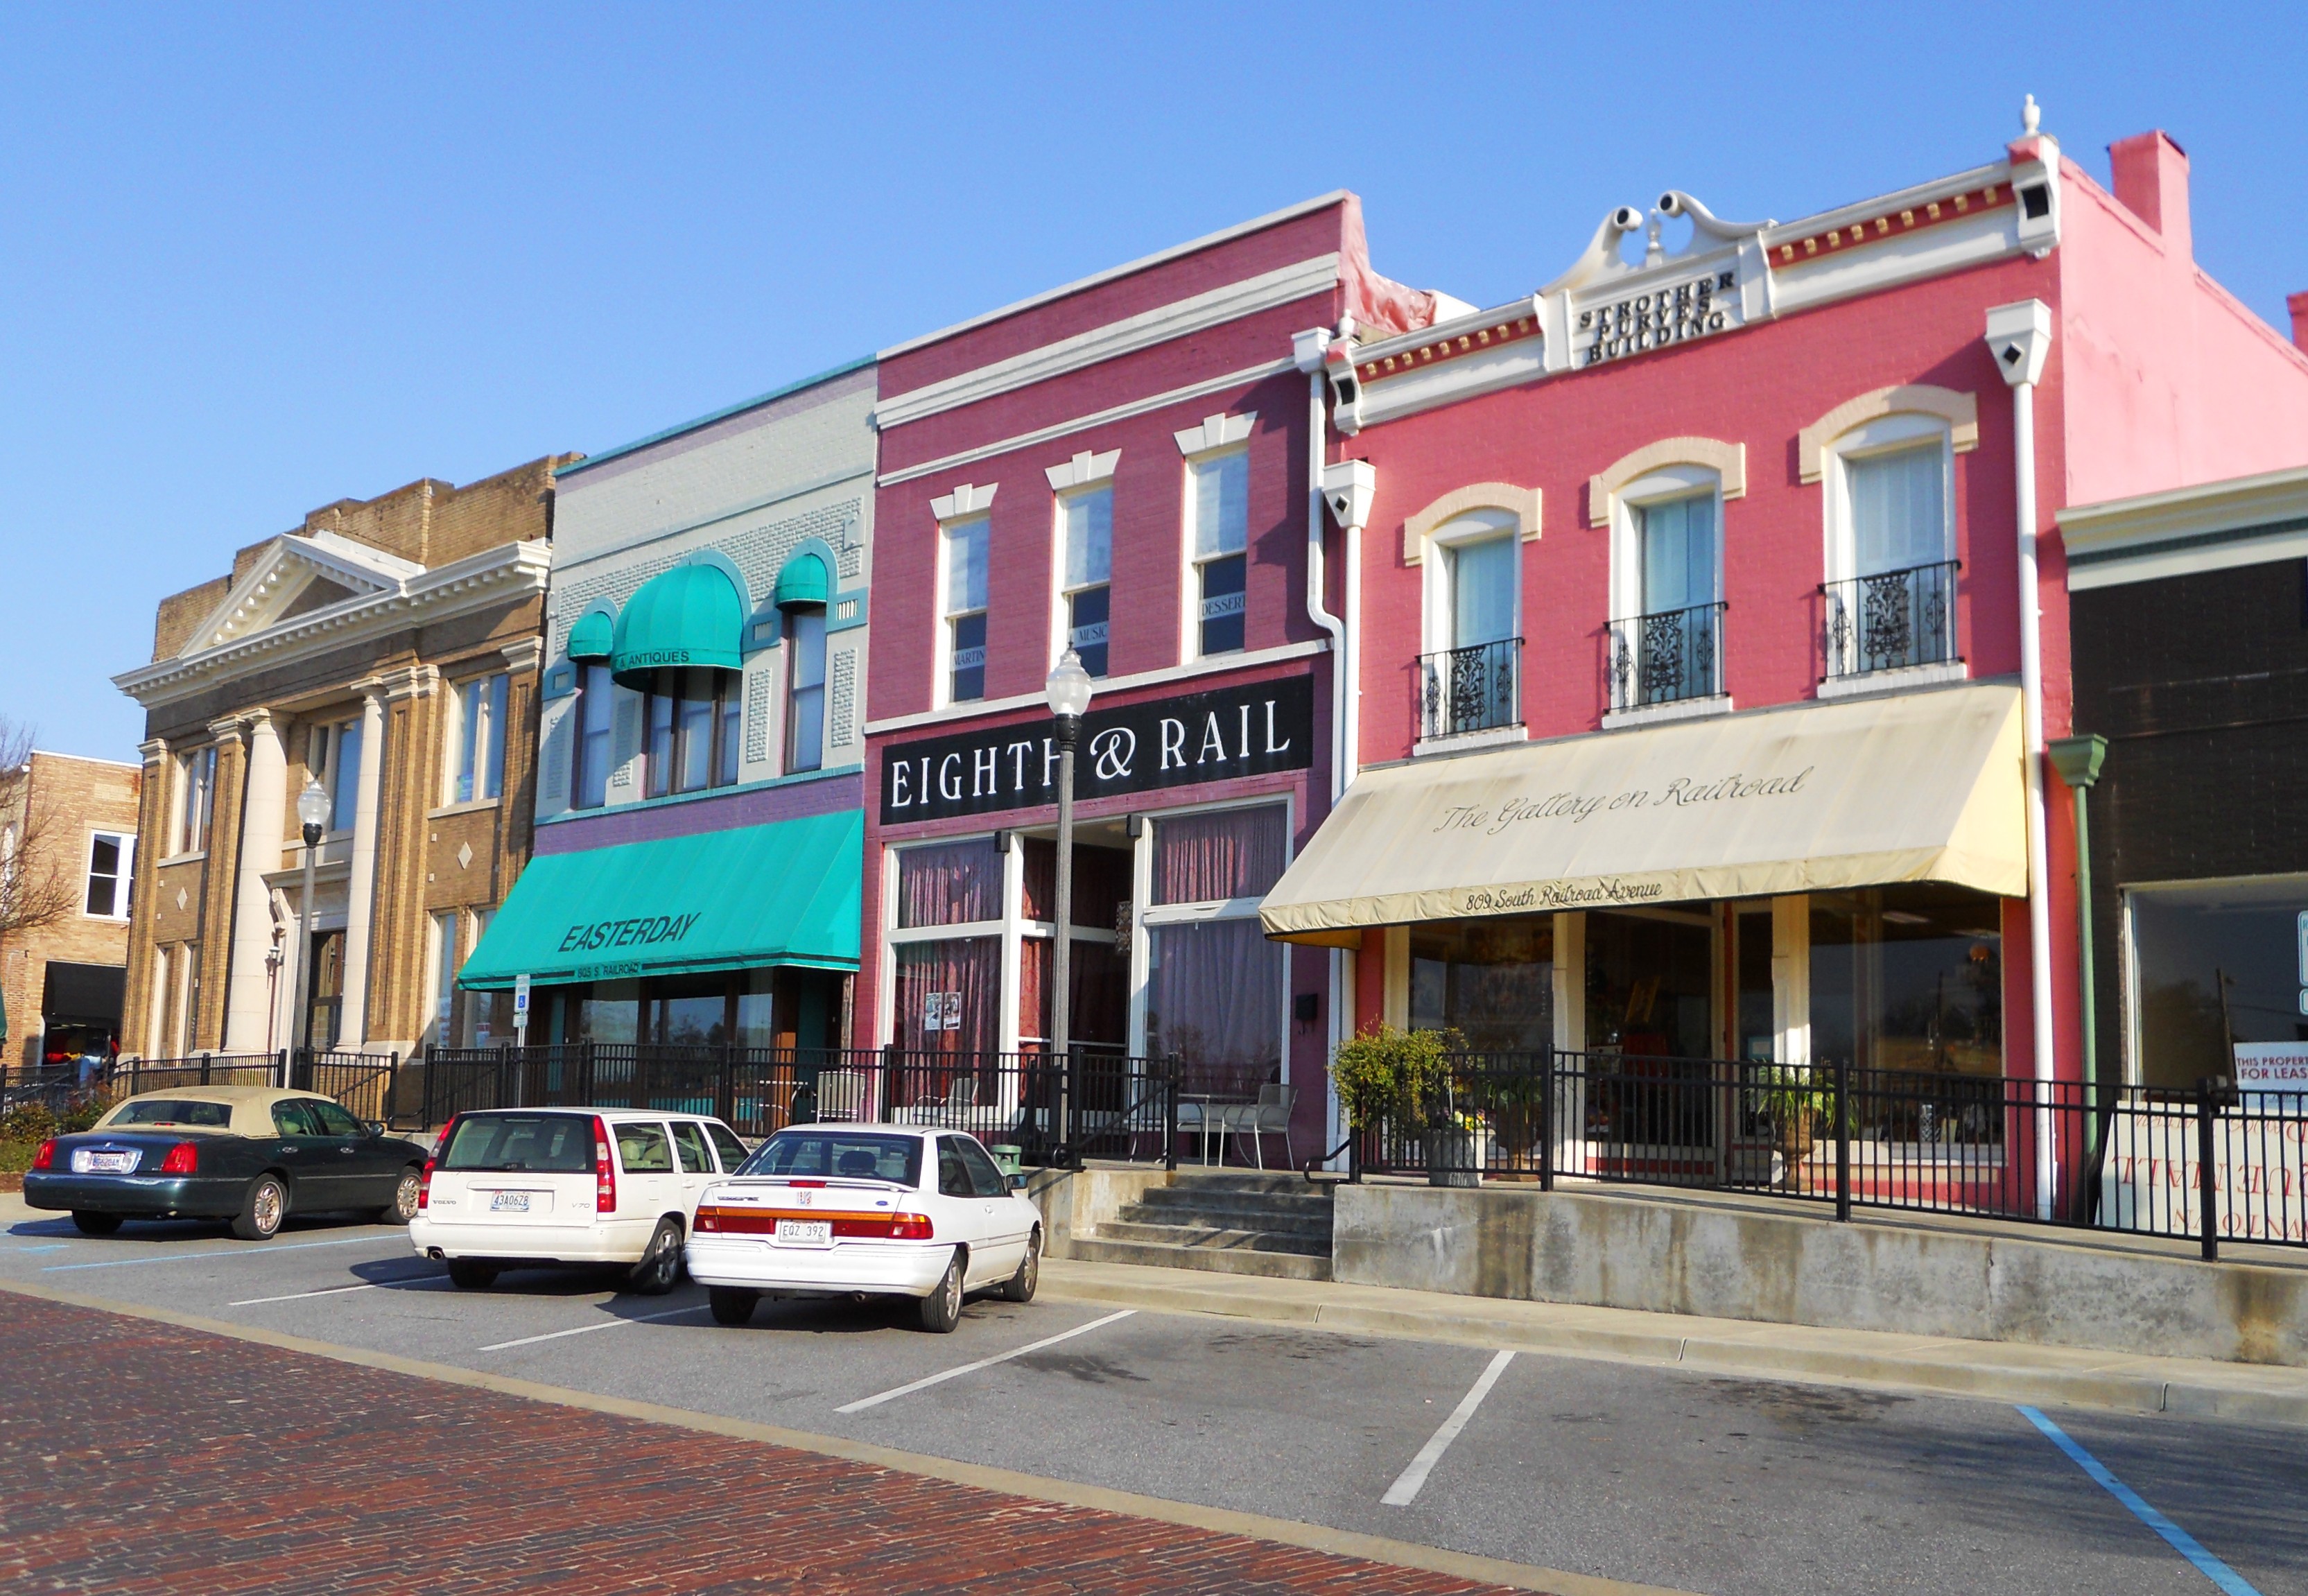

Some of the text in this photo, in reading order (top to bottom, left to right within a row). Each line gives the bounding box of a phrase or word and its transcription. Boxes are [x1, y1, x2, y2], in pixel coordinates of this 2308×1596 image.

[1579, 272, 1735, 329] STROTHER
[1597, 296, 1711, 340] PURVES
[1588, 312, 1725, 363] BUILDING
[1079, 624, 1107, 641] MUSIC
[629, 651, 689, 665] ANTIQUES
[1090, 727, 1136, 781] &
[1159, 700, 1290, 770] RAIL
[1433, 765, 1814, 835] The Gallery on Railroad
[1466, 878, 1663, 910] 809 South Railroad Avenue
[557, 912, 702, 953] EASTERDAY
[603, 963, 639, 975] RAILROAD
[2237, 1057, 2259, 1066] THIS
[2241, 1067, 2307, 1079] FOR LEAS
[494, 1195, 529, 1206] 43A06Z8
[783, 1225, 824, 1237] EQZ 392
